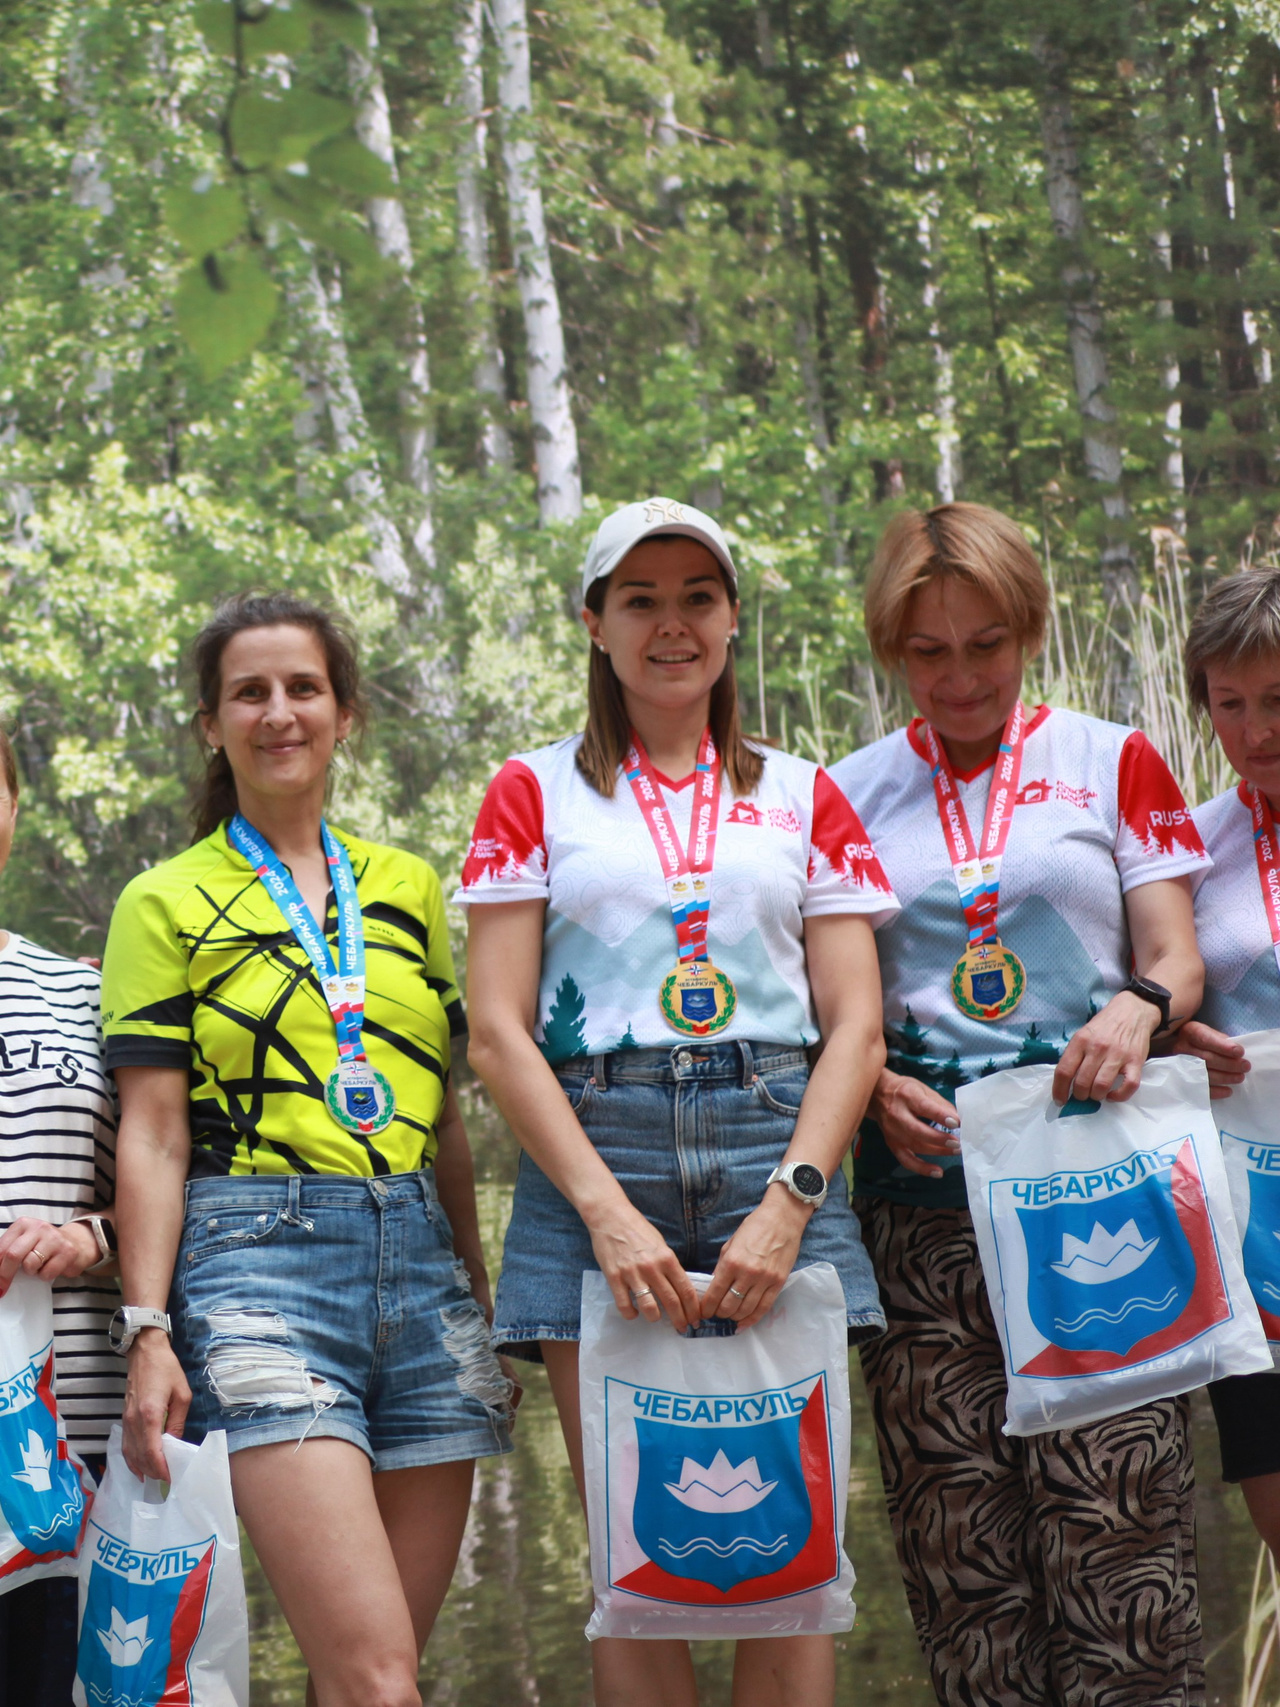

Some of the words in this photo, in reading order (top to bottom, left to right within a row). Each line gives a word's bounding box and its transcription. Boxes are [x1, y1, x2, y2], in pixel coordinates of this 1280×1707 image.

[638, 775, 656, 801] 2024
[702, 772, 714, 798] 2024
[986, 788, 1008, 851] ЧЕБАРКУЛЬ
[1000, 755, 1015, 782] 2024
[651, 806, 680, 872] ЧЕБАРКУЛЬ
[694, 803, 712, 866] ЧЕБАРКУЛЬ
[1260, 833, 1274, 862] 2024
[266, 870, 290, 897] 2024
[336, 867, 350, 894] 2024
[287, 902, 328, 970] ЧЕБАРКУЛЬ
[343, 900, 358, 970] ЧЕБАРКУЛЬ
[1011, 1150, 1178, 1206] ЧЕБАРКУЛЬ
[633, 1391, 809, 1424] ЧЕБАРКУЛЬ
